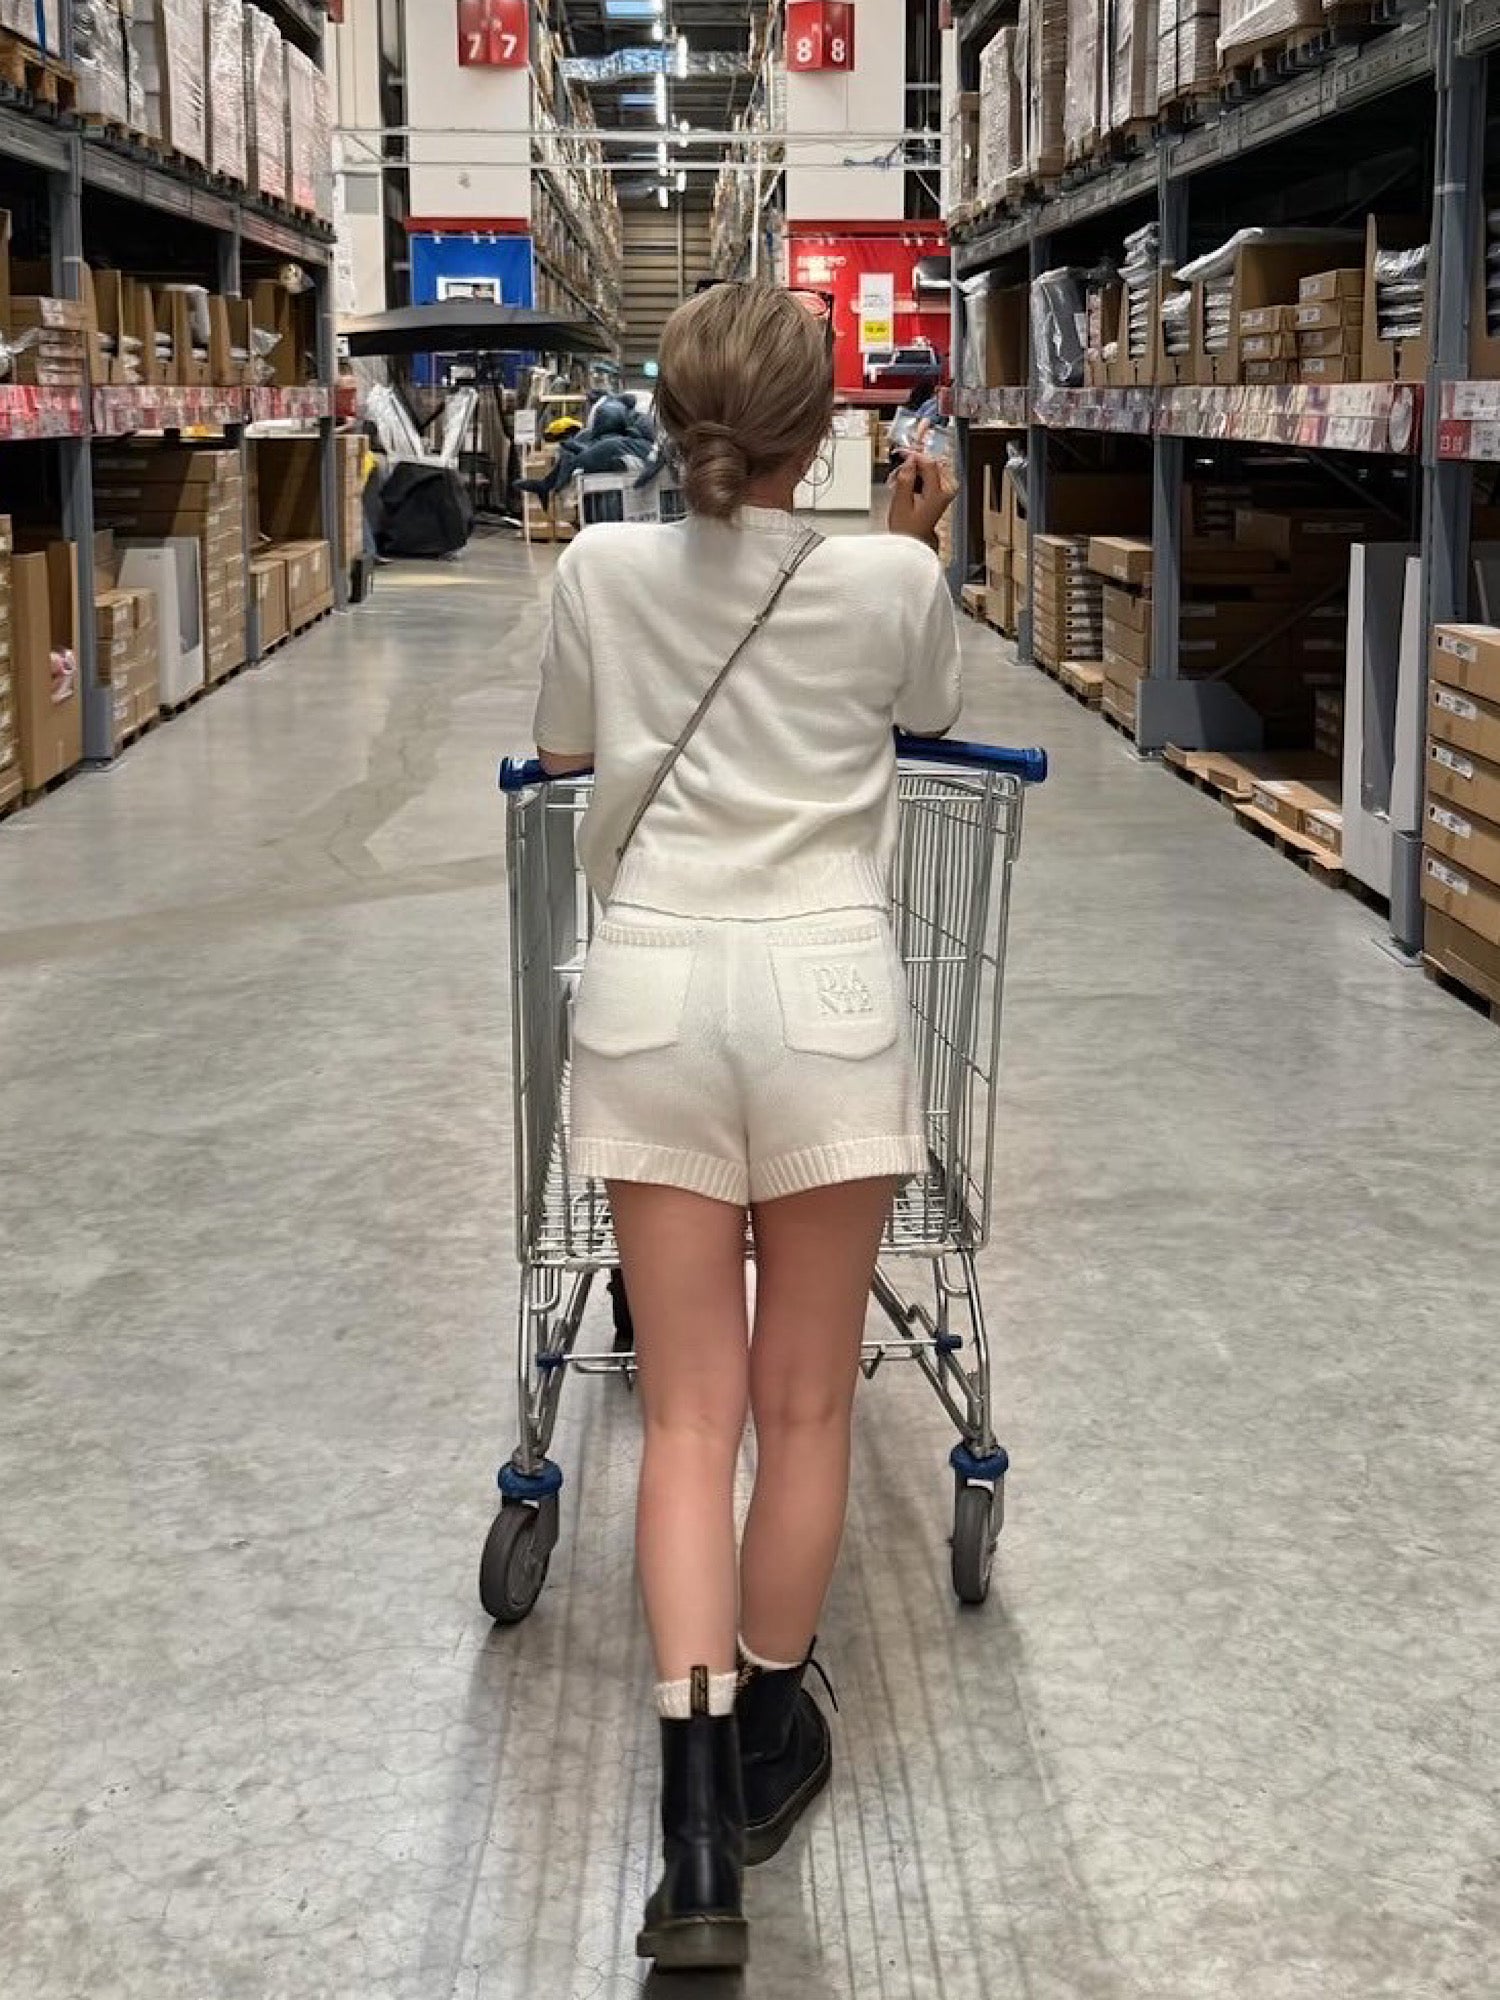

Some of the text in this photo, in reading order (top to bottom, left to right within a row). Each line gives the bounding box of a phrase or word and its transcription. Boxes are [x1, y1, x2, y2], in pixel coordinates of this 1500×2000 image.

[467, 33, 481, 59] 7
[501, 34, 517, 59] 7
[797, 37, 812, 62] 8
[832, 37, 845, 62] 8
